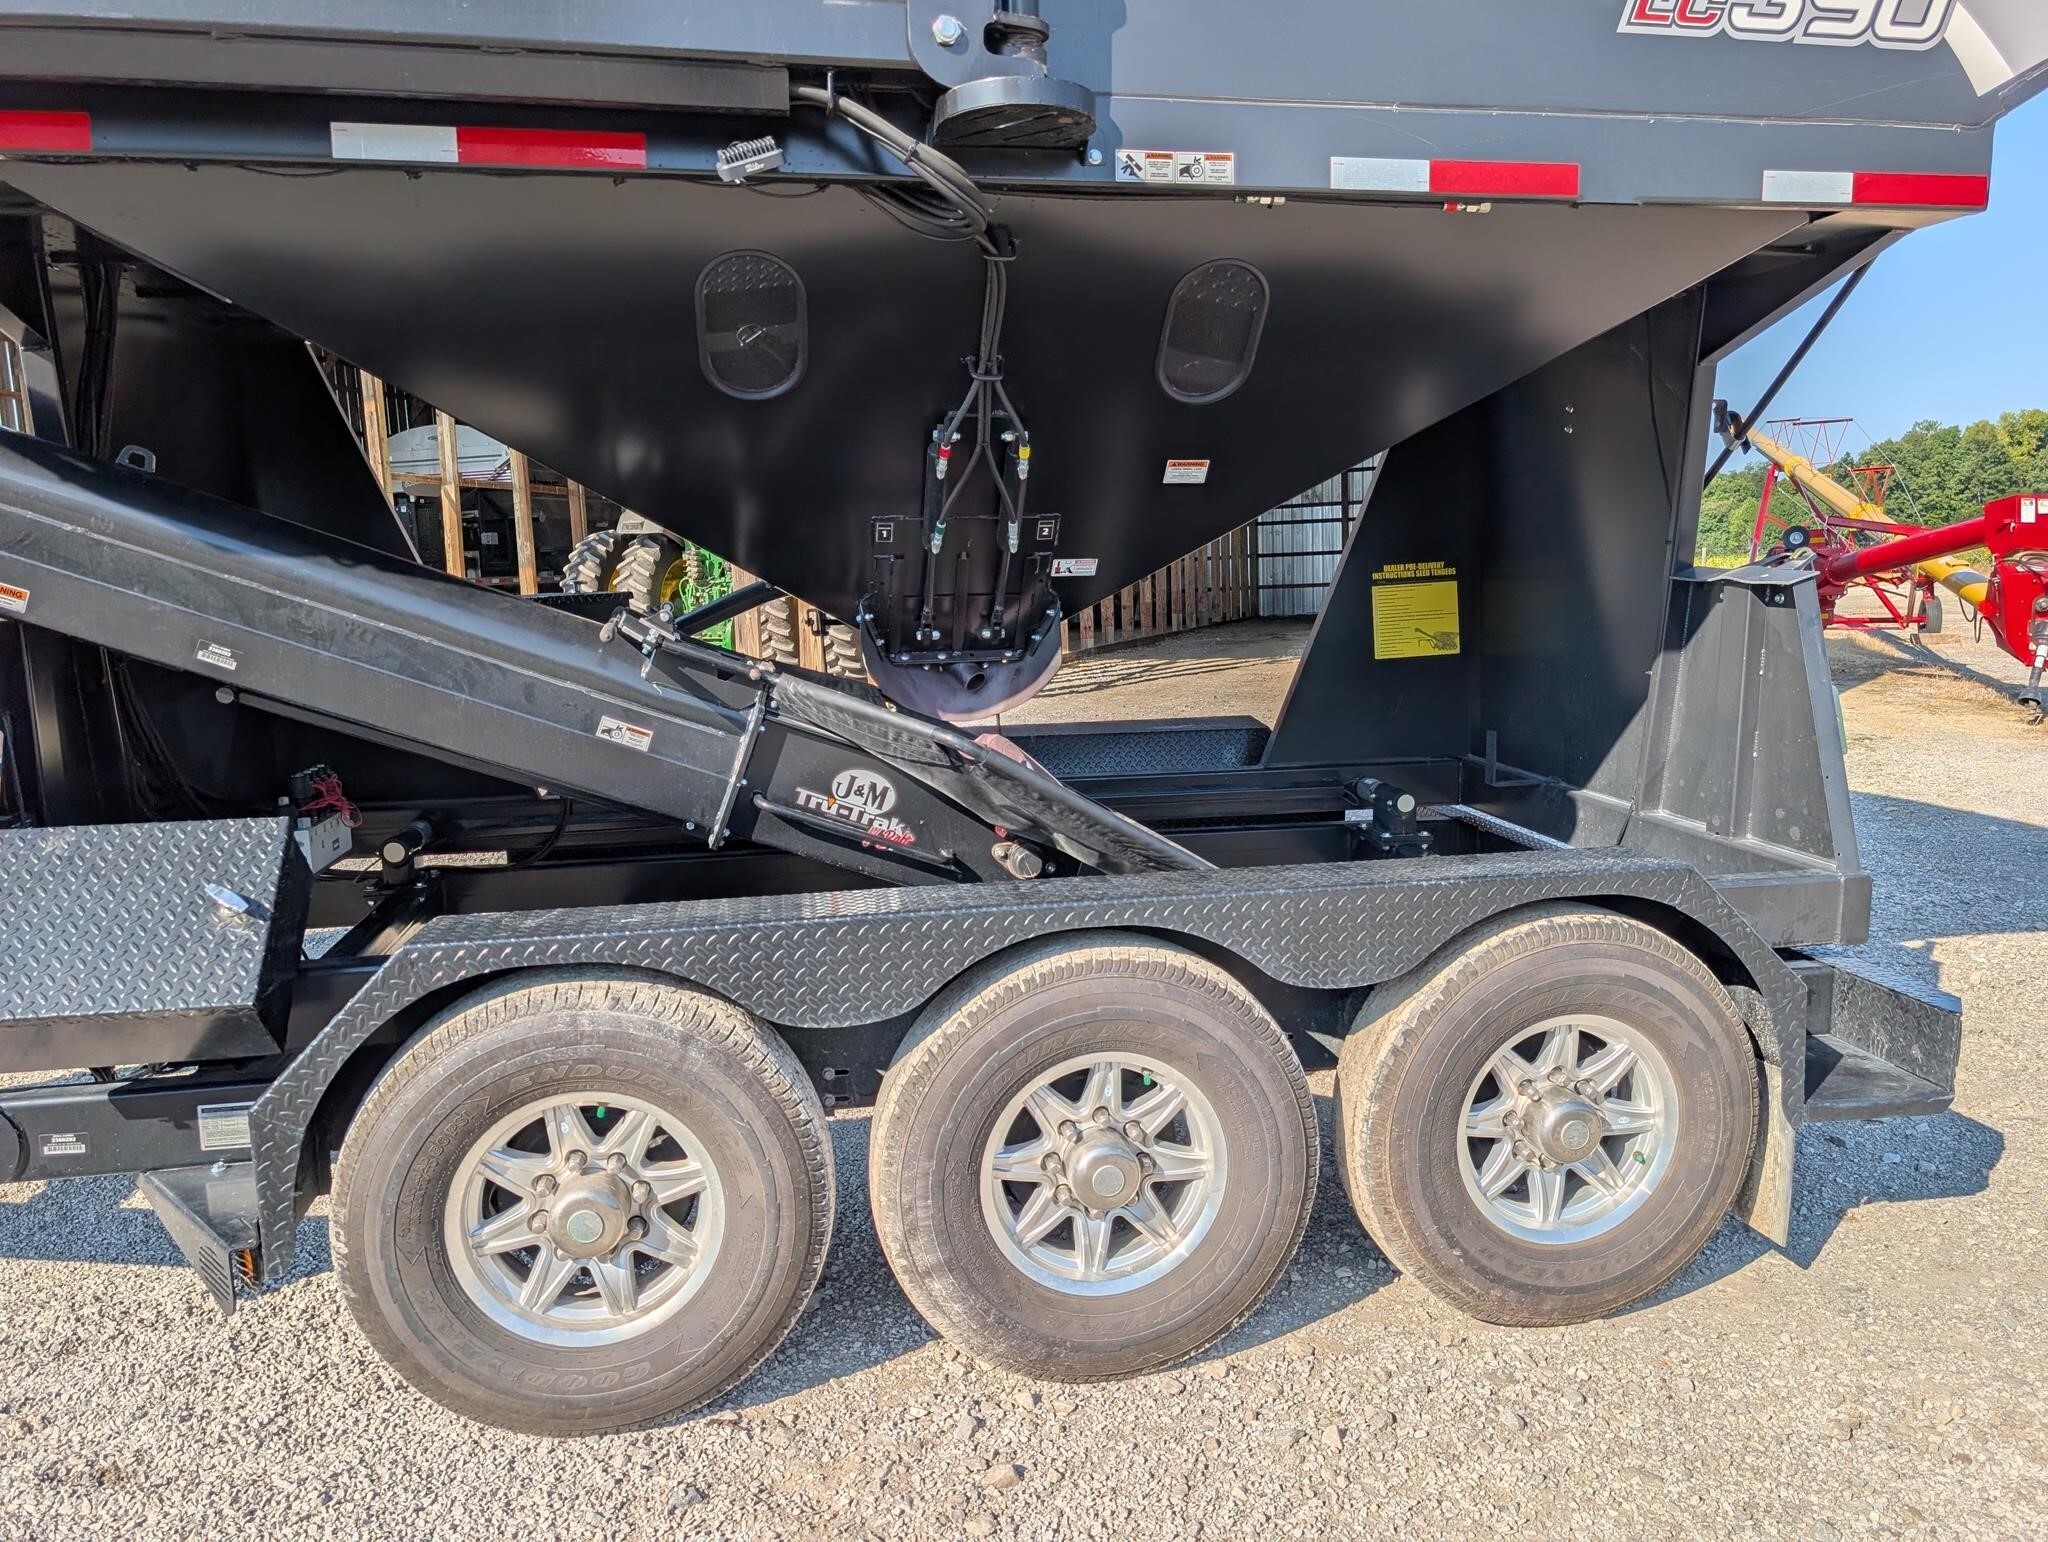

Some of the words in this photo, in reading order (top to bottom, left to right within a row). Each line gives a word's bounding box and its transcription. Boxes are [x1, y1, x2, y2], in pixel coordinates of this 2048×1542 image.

[881, 530, 888, 538] 1
[1041, 527, 1049, 536] 2
[1405, 561, 1445, 571] PRE-DELIVERY
[1372, 571, 1415, 580] INSTRUCTIONS
[1430, 567, 1457, 576] TENDERS
